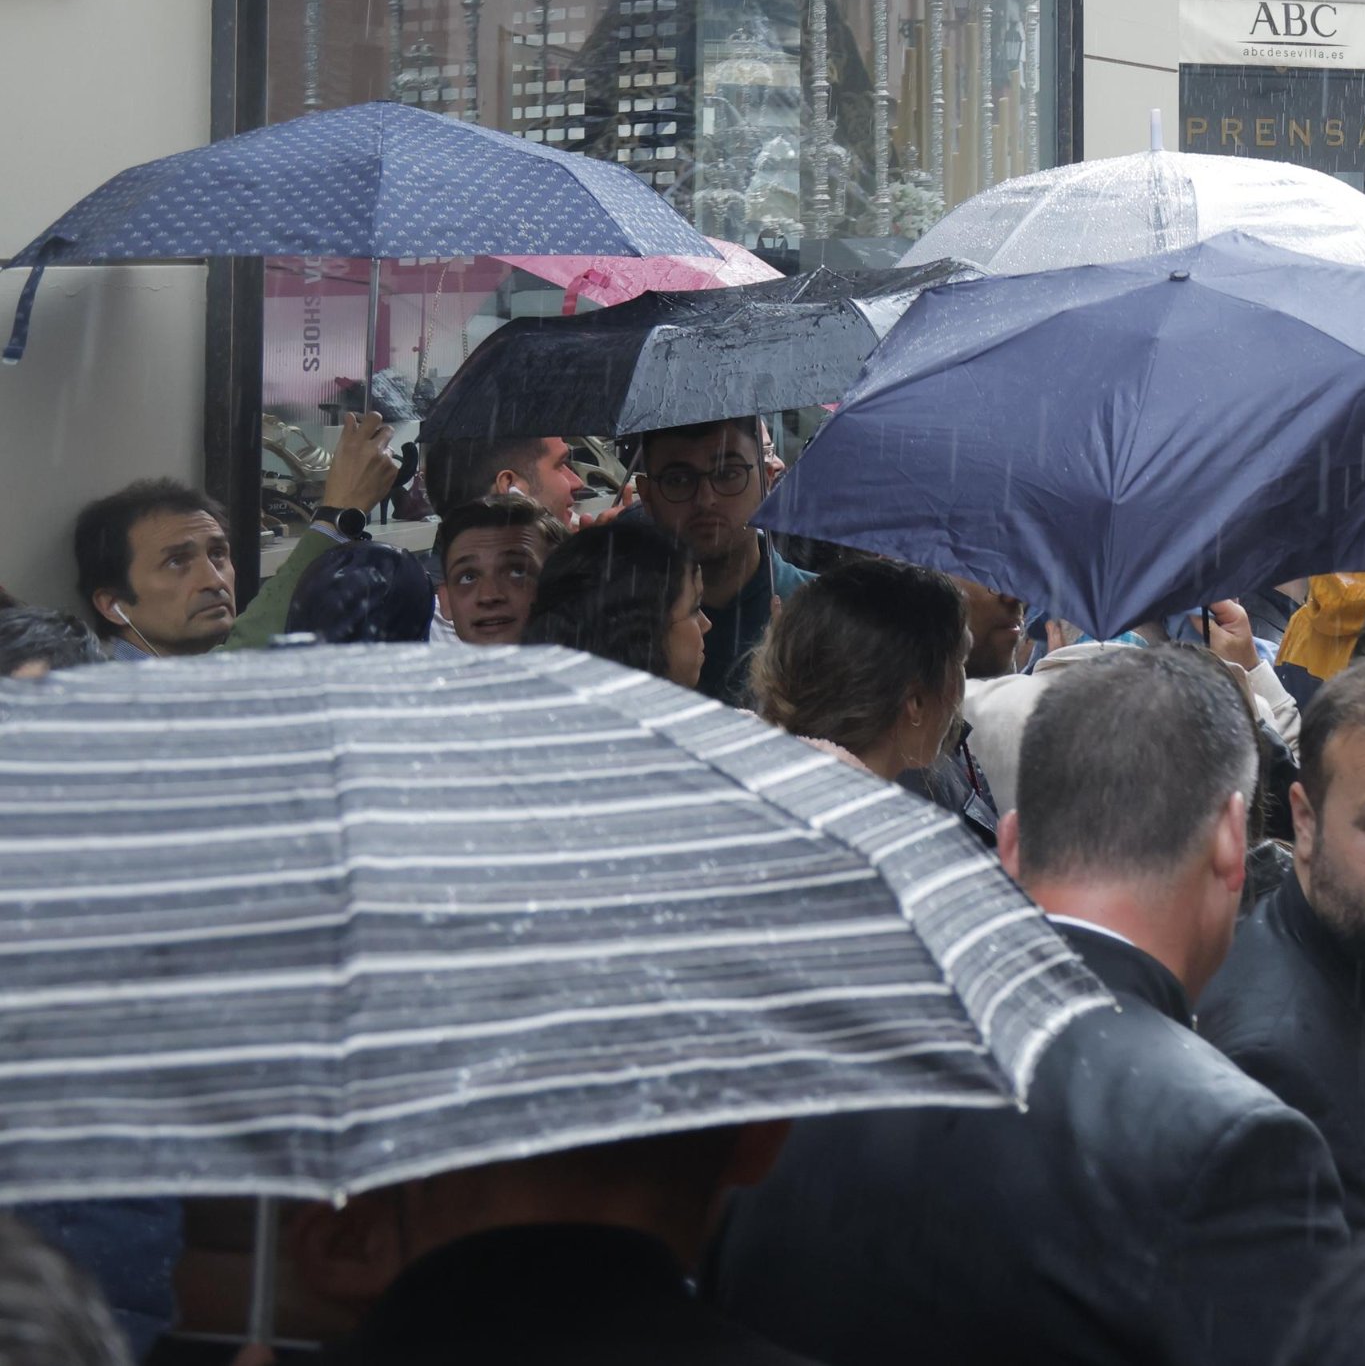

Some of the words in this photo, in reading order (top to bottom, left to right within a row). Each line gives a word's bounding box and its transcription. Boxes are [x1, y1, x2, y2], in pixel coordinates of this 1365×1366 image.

[1248, 1, 1337, 38] ABC
[1242, 47, 1345, 60] abcdesevilla.es
[302, 294, 321, 373] SHOES
